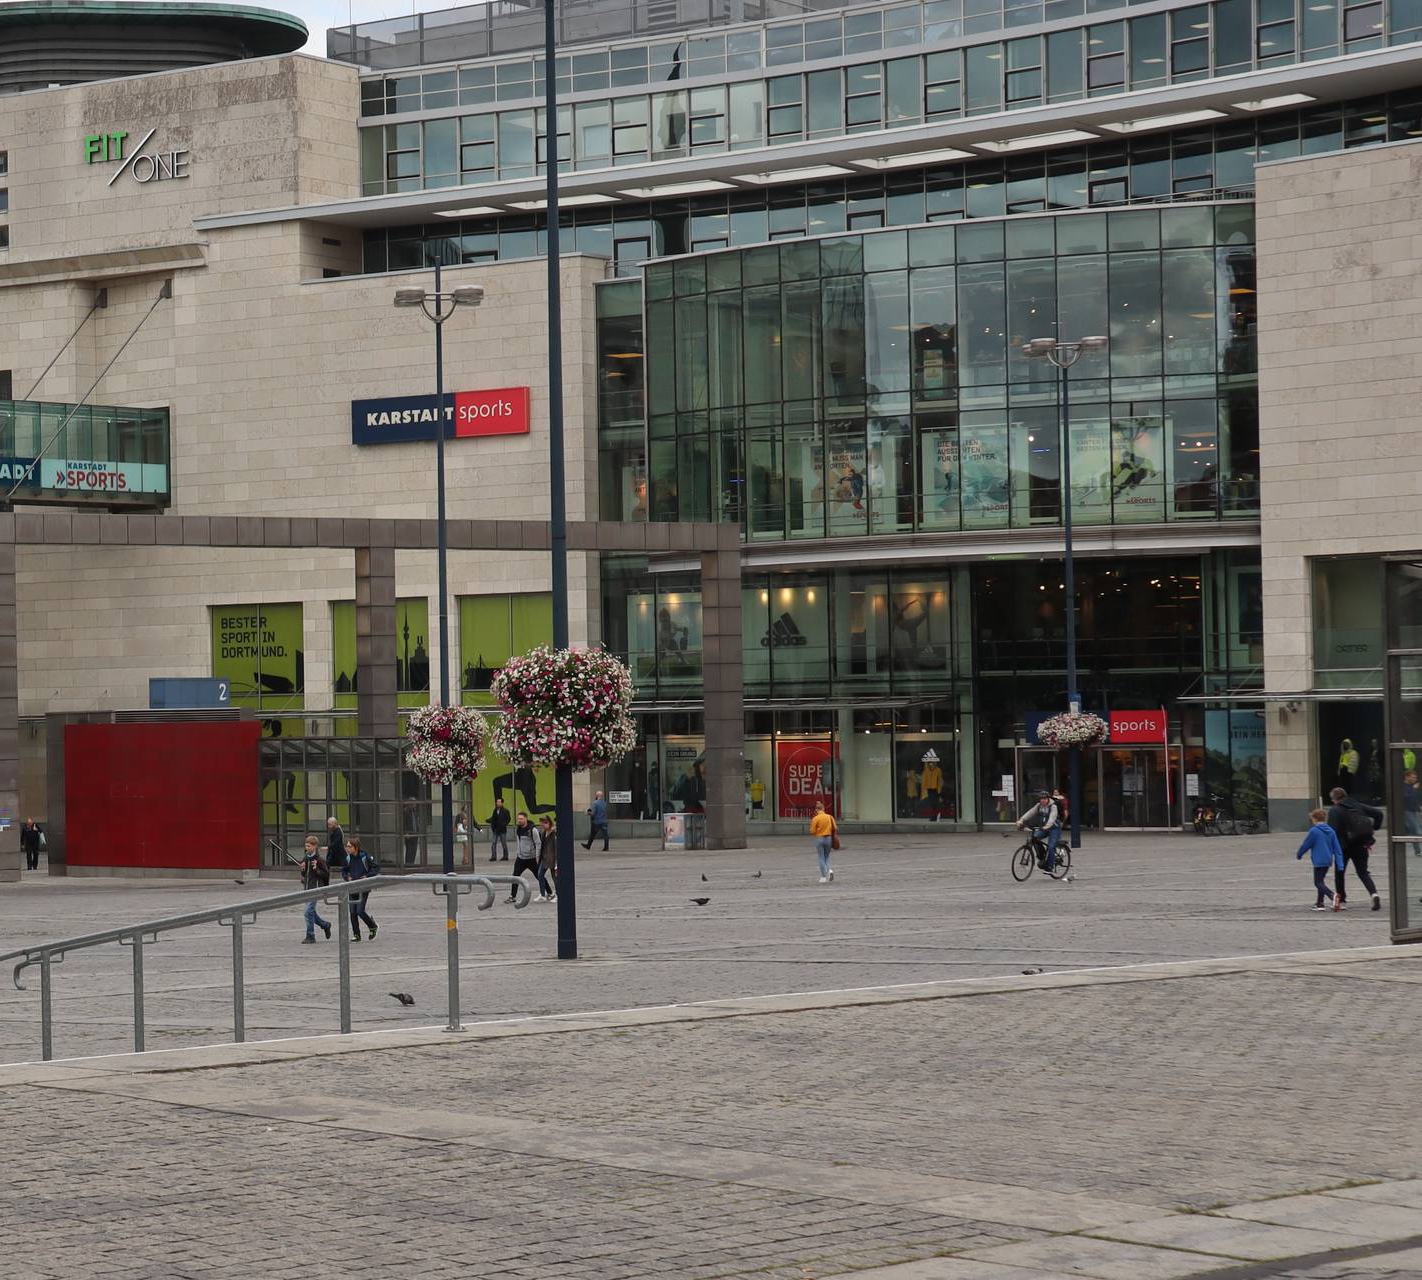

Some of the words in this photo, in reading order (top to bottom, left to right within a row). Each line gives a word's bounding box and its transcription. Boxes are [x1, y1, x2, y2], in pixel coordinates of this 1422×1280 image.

[84, 130, 128, 163] FIT
[132, 149, 189, 183] ONE
[459, 400, 512, 423] sports
[68, 462, 107, 471] KARSTADT
[67, 471, 126, 488] SPORTS
[221, 617, 267, 629] BESTER
[221, 632, 257, 644] SPORT
[263, 631, 275, 642] IN
[761, 631, 807, 647] adidas
[221, 646, 287, 658] DORTMUND.
[219, 683, 227, 701] 2
[1113, 719, 1156, 734] sports
[789, 765, 824, 778] SUPE
